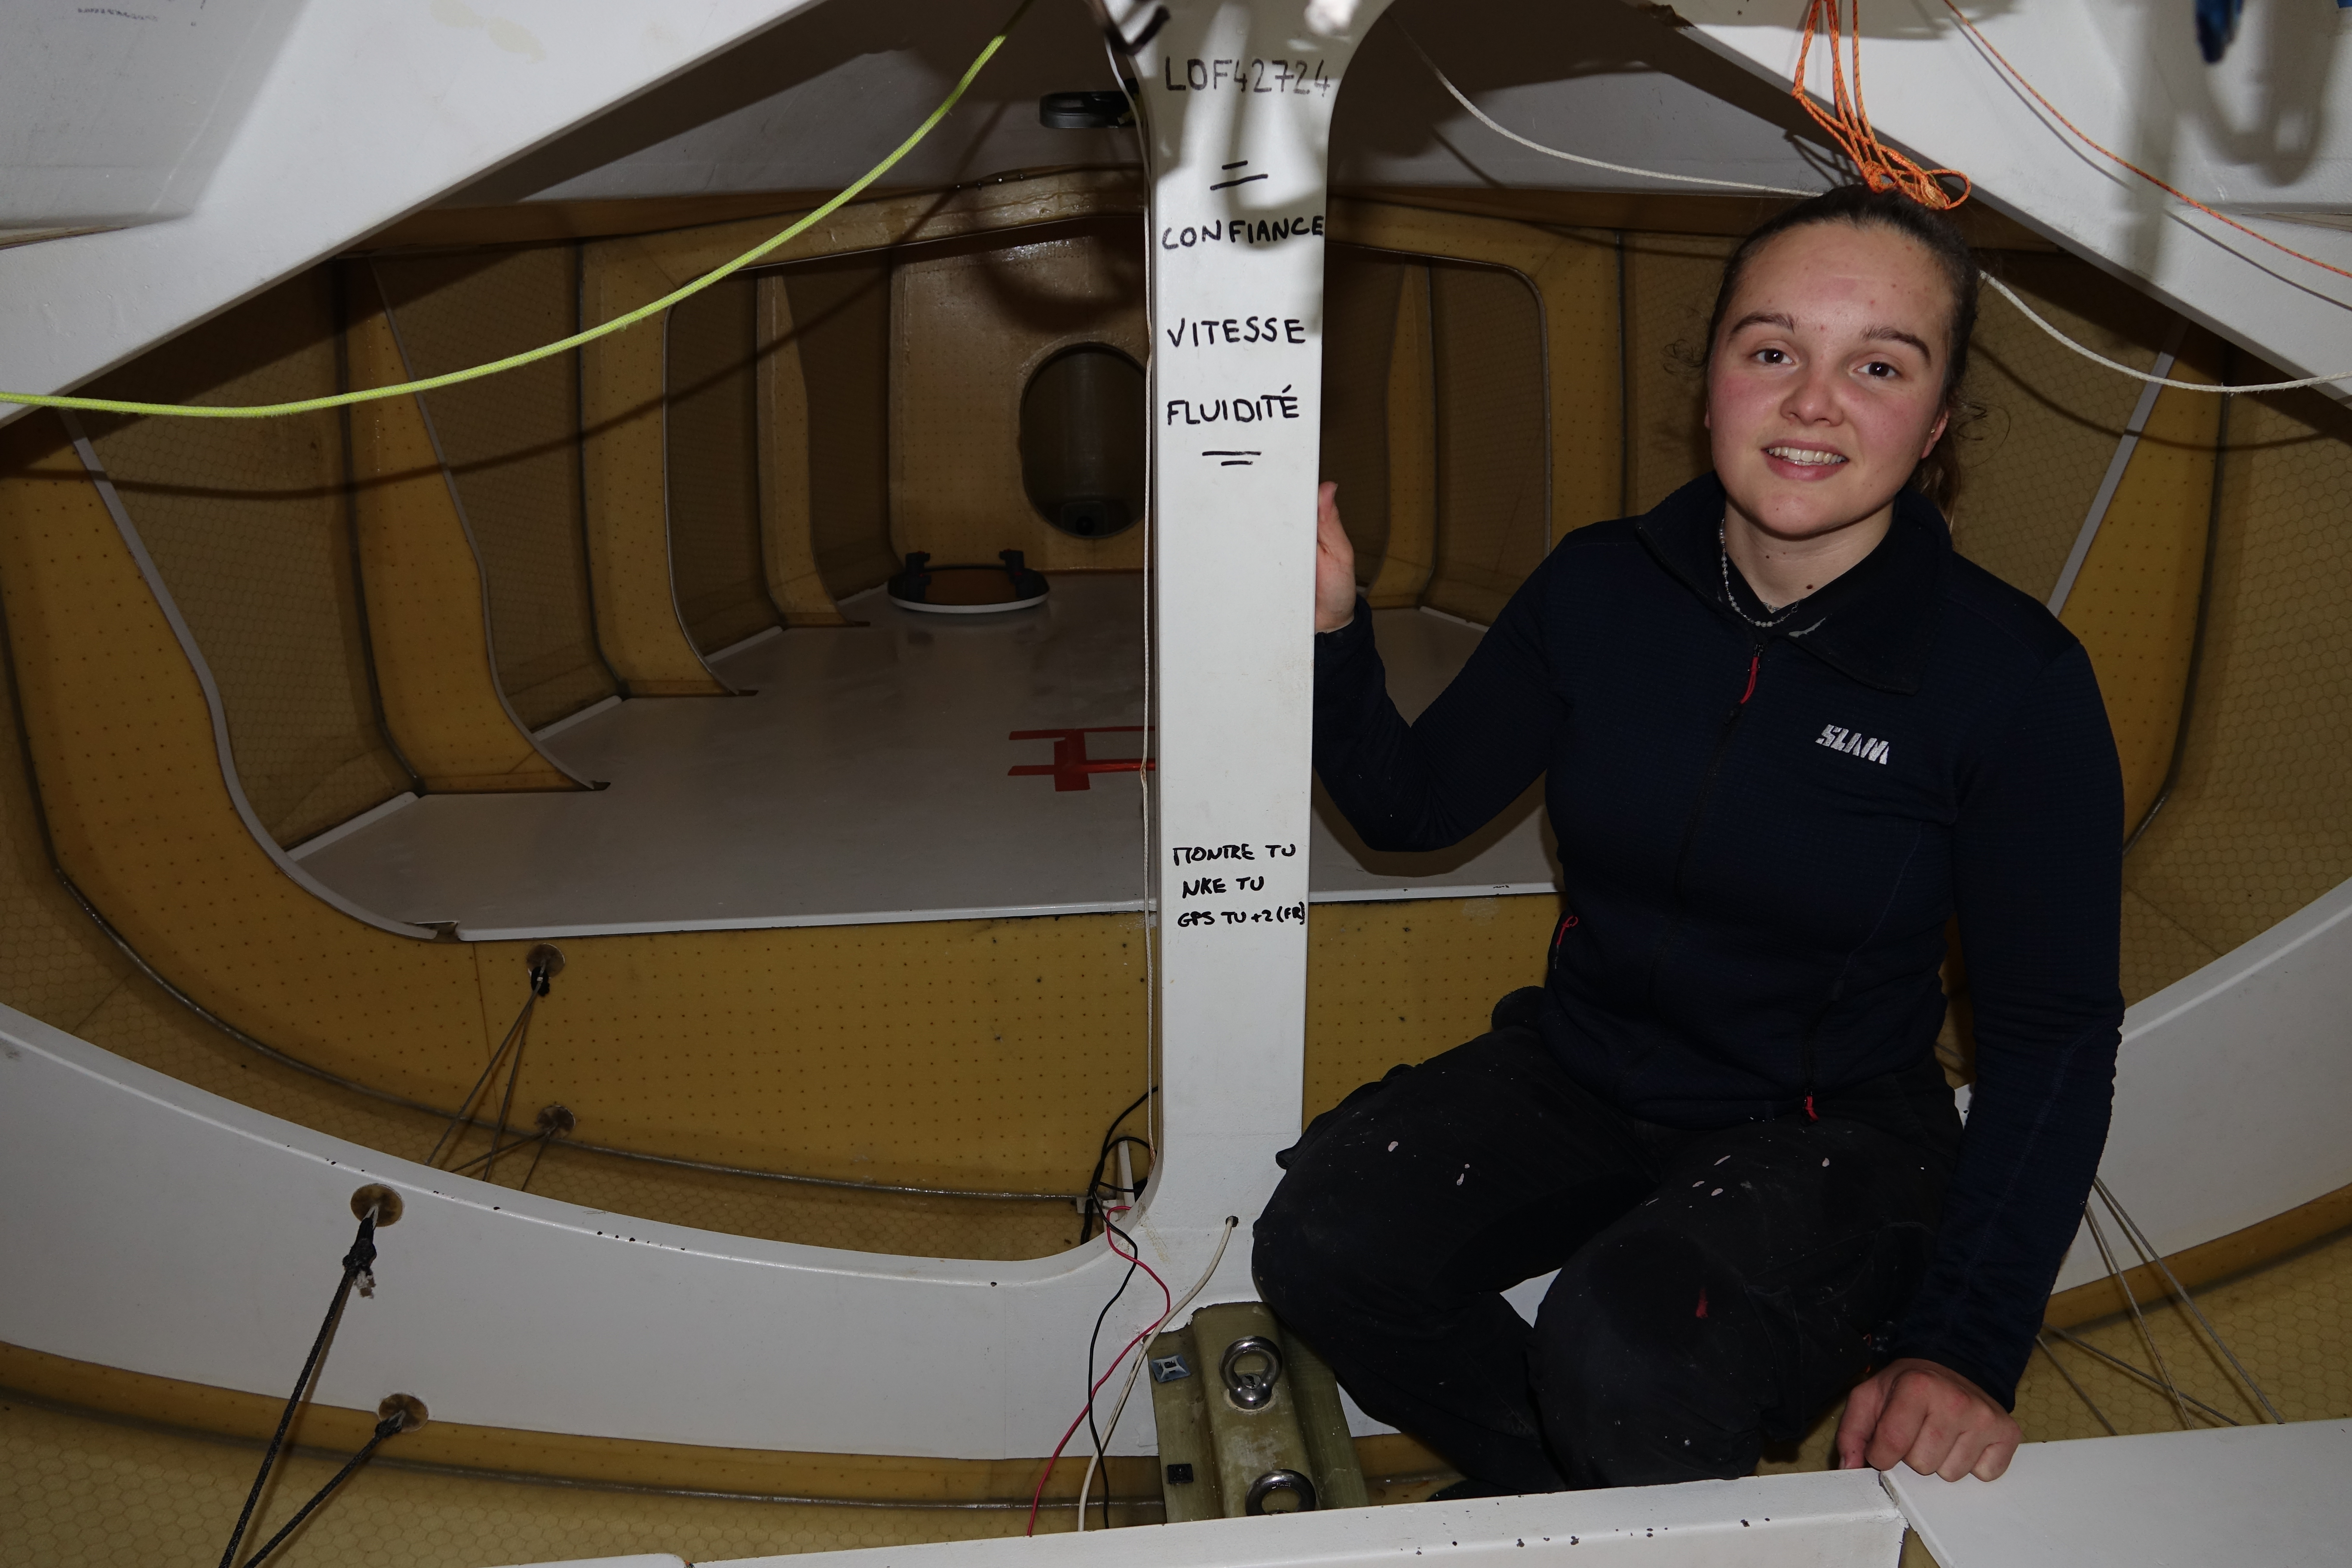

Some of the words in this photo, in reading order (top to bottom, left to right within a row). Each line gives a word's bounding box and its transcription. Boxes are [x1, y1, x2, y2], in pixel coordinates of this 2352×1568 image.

[1162, 215, 1324, 249] CONFIANCE
[1167, 316, 1306, 347] VITESSE
[1167, 384, 1300, 426] FLUIDITÉ
[1815, 724, 1890, 765] SLAM
[1265, 843, 1296, 858] TU
[1182, 877, 1227, 899] NKE
[1236, 876, 1265, 891] TU
[1177, 911, 1215, 927] GPS
